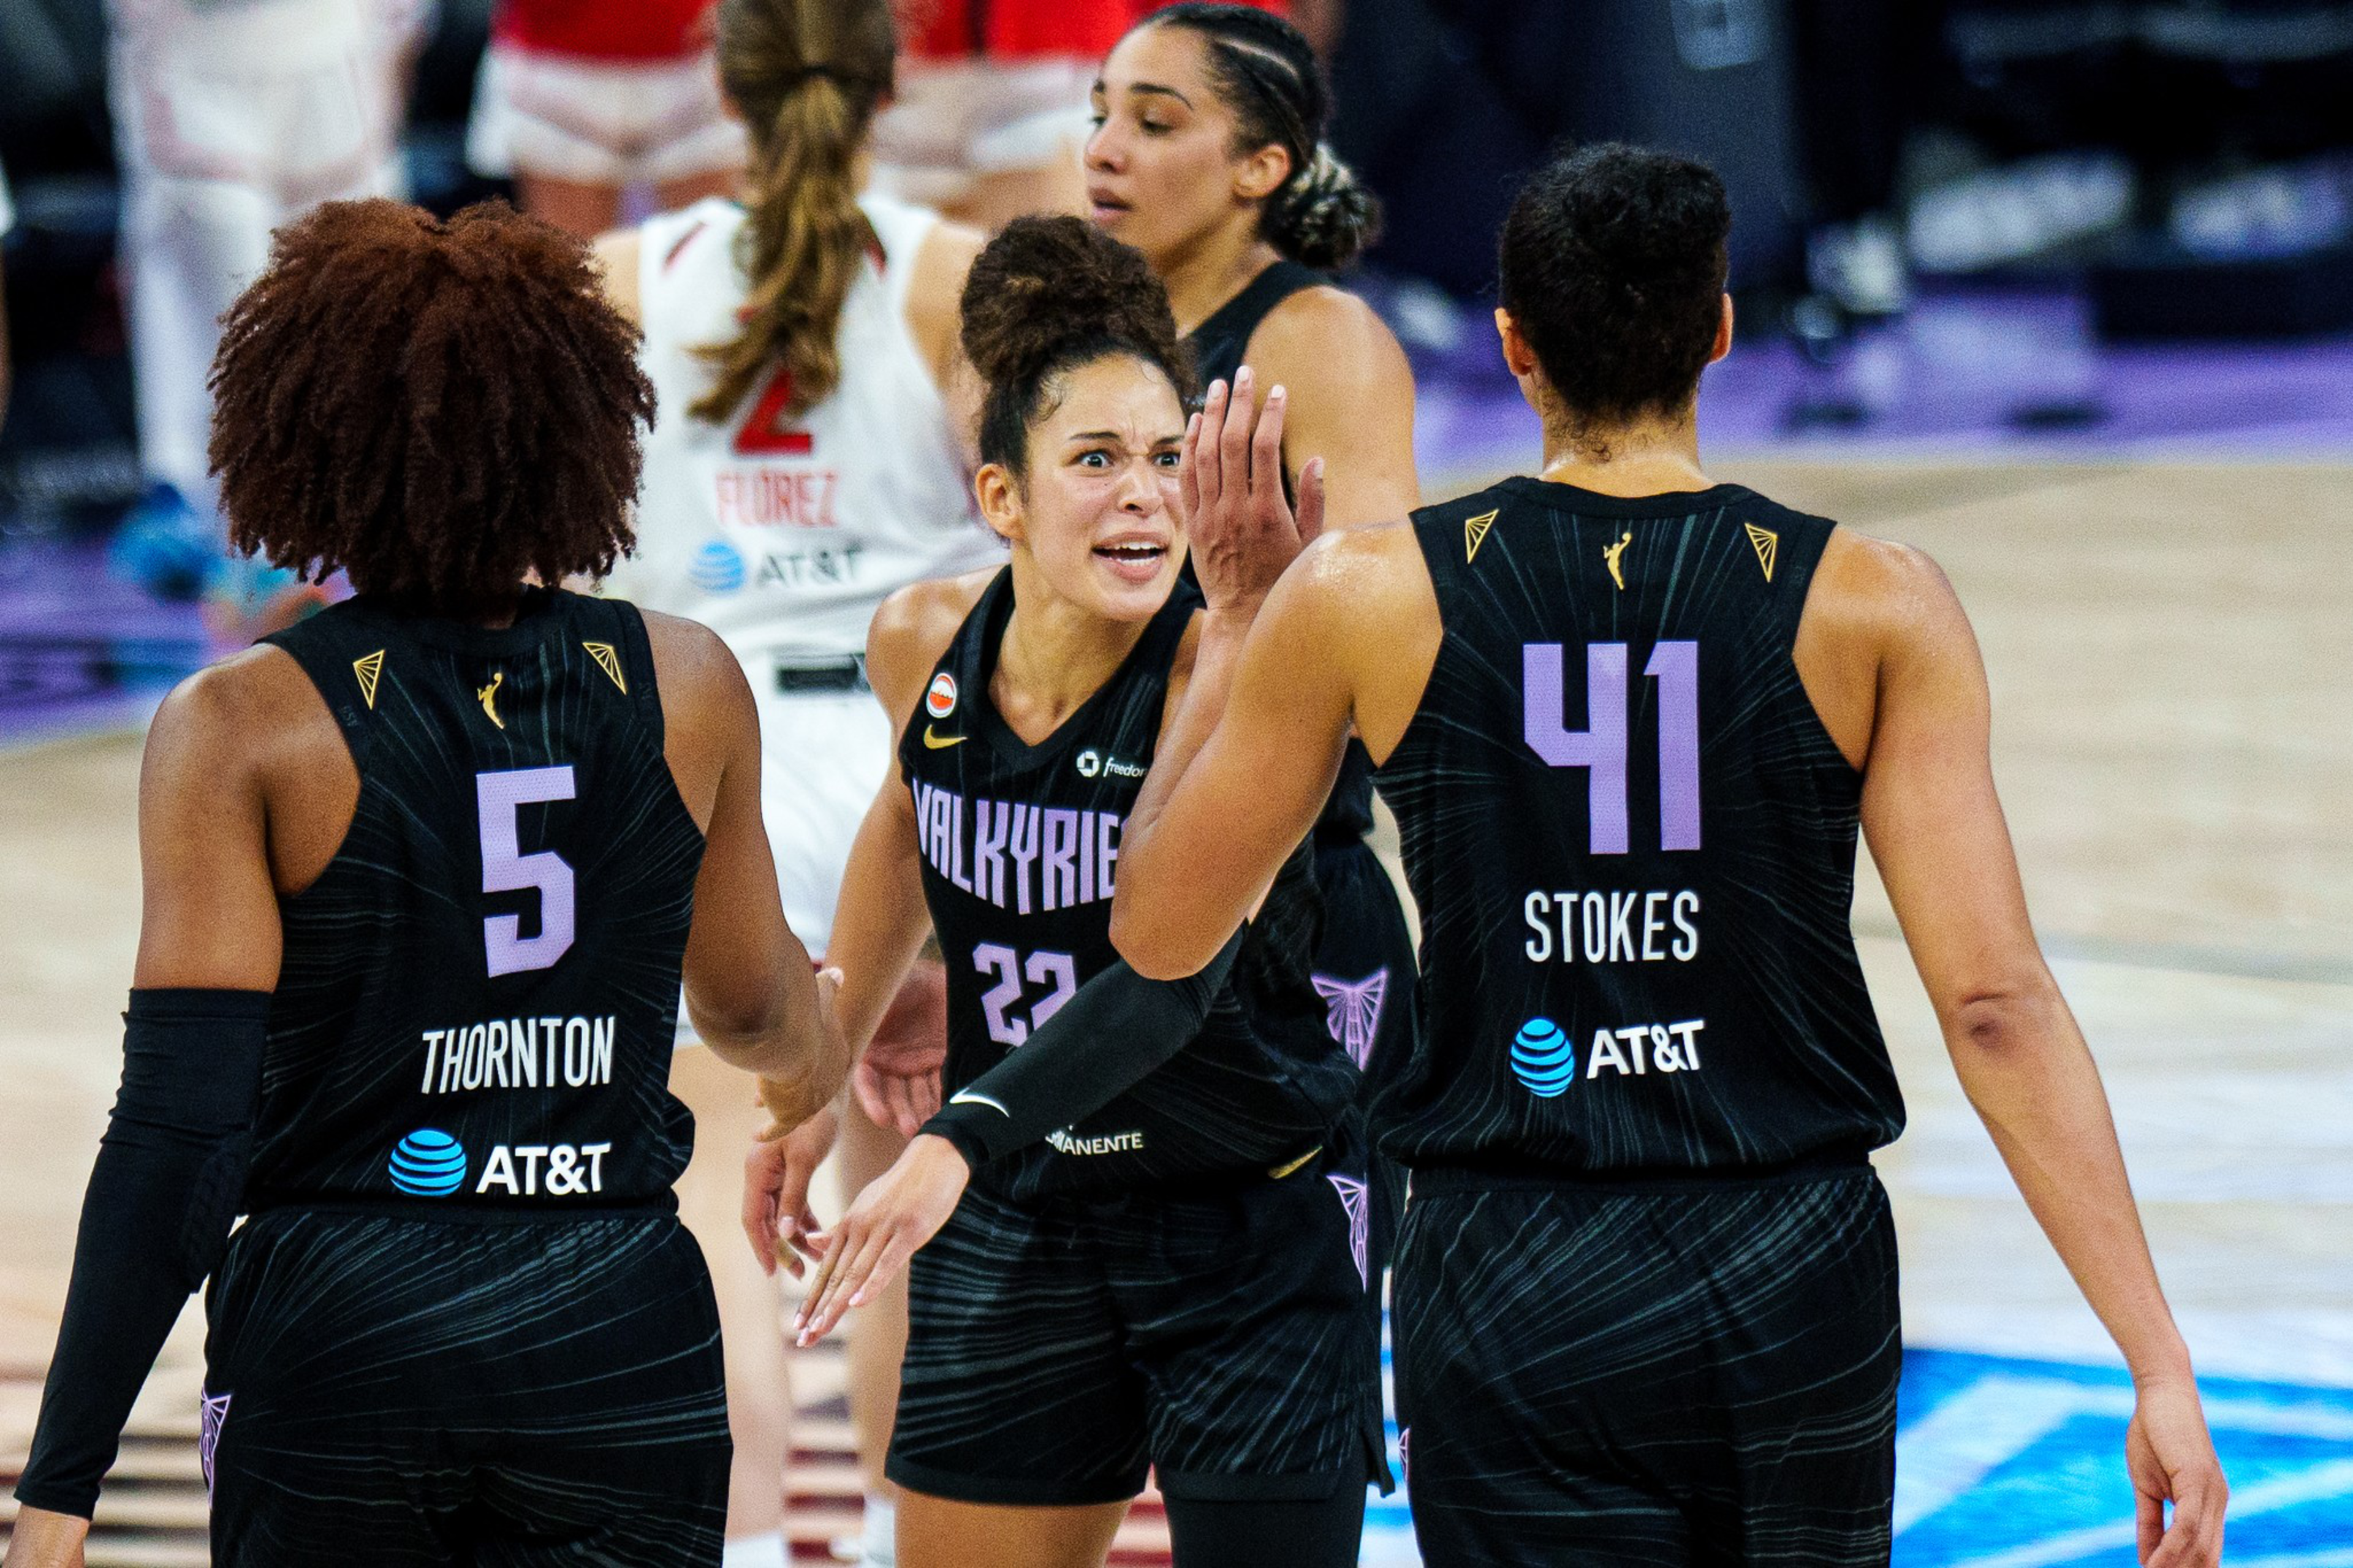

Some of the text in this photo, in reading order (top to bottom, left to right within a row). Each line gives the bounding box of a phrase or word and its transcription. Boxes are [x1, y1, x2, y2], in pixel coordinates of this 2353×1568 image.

[714, 468, 839, 529] FLOREZ
[756, 542, 865, 588] AT&T
[1523, 640, 1700, 855] 41
[476, 765, 577, 979] 5
[912, 777, 1131, 915] VALKYRIE
[1525, 890, 1699, 963] STOKES
[972, 941, 1077, 1048] 22
[422, 1015, 615, 1094] THORNTON
[1586, 1018, 1705, 1080] AT&T
[476, 1142, 612, 1196] AT&T
